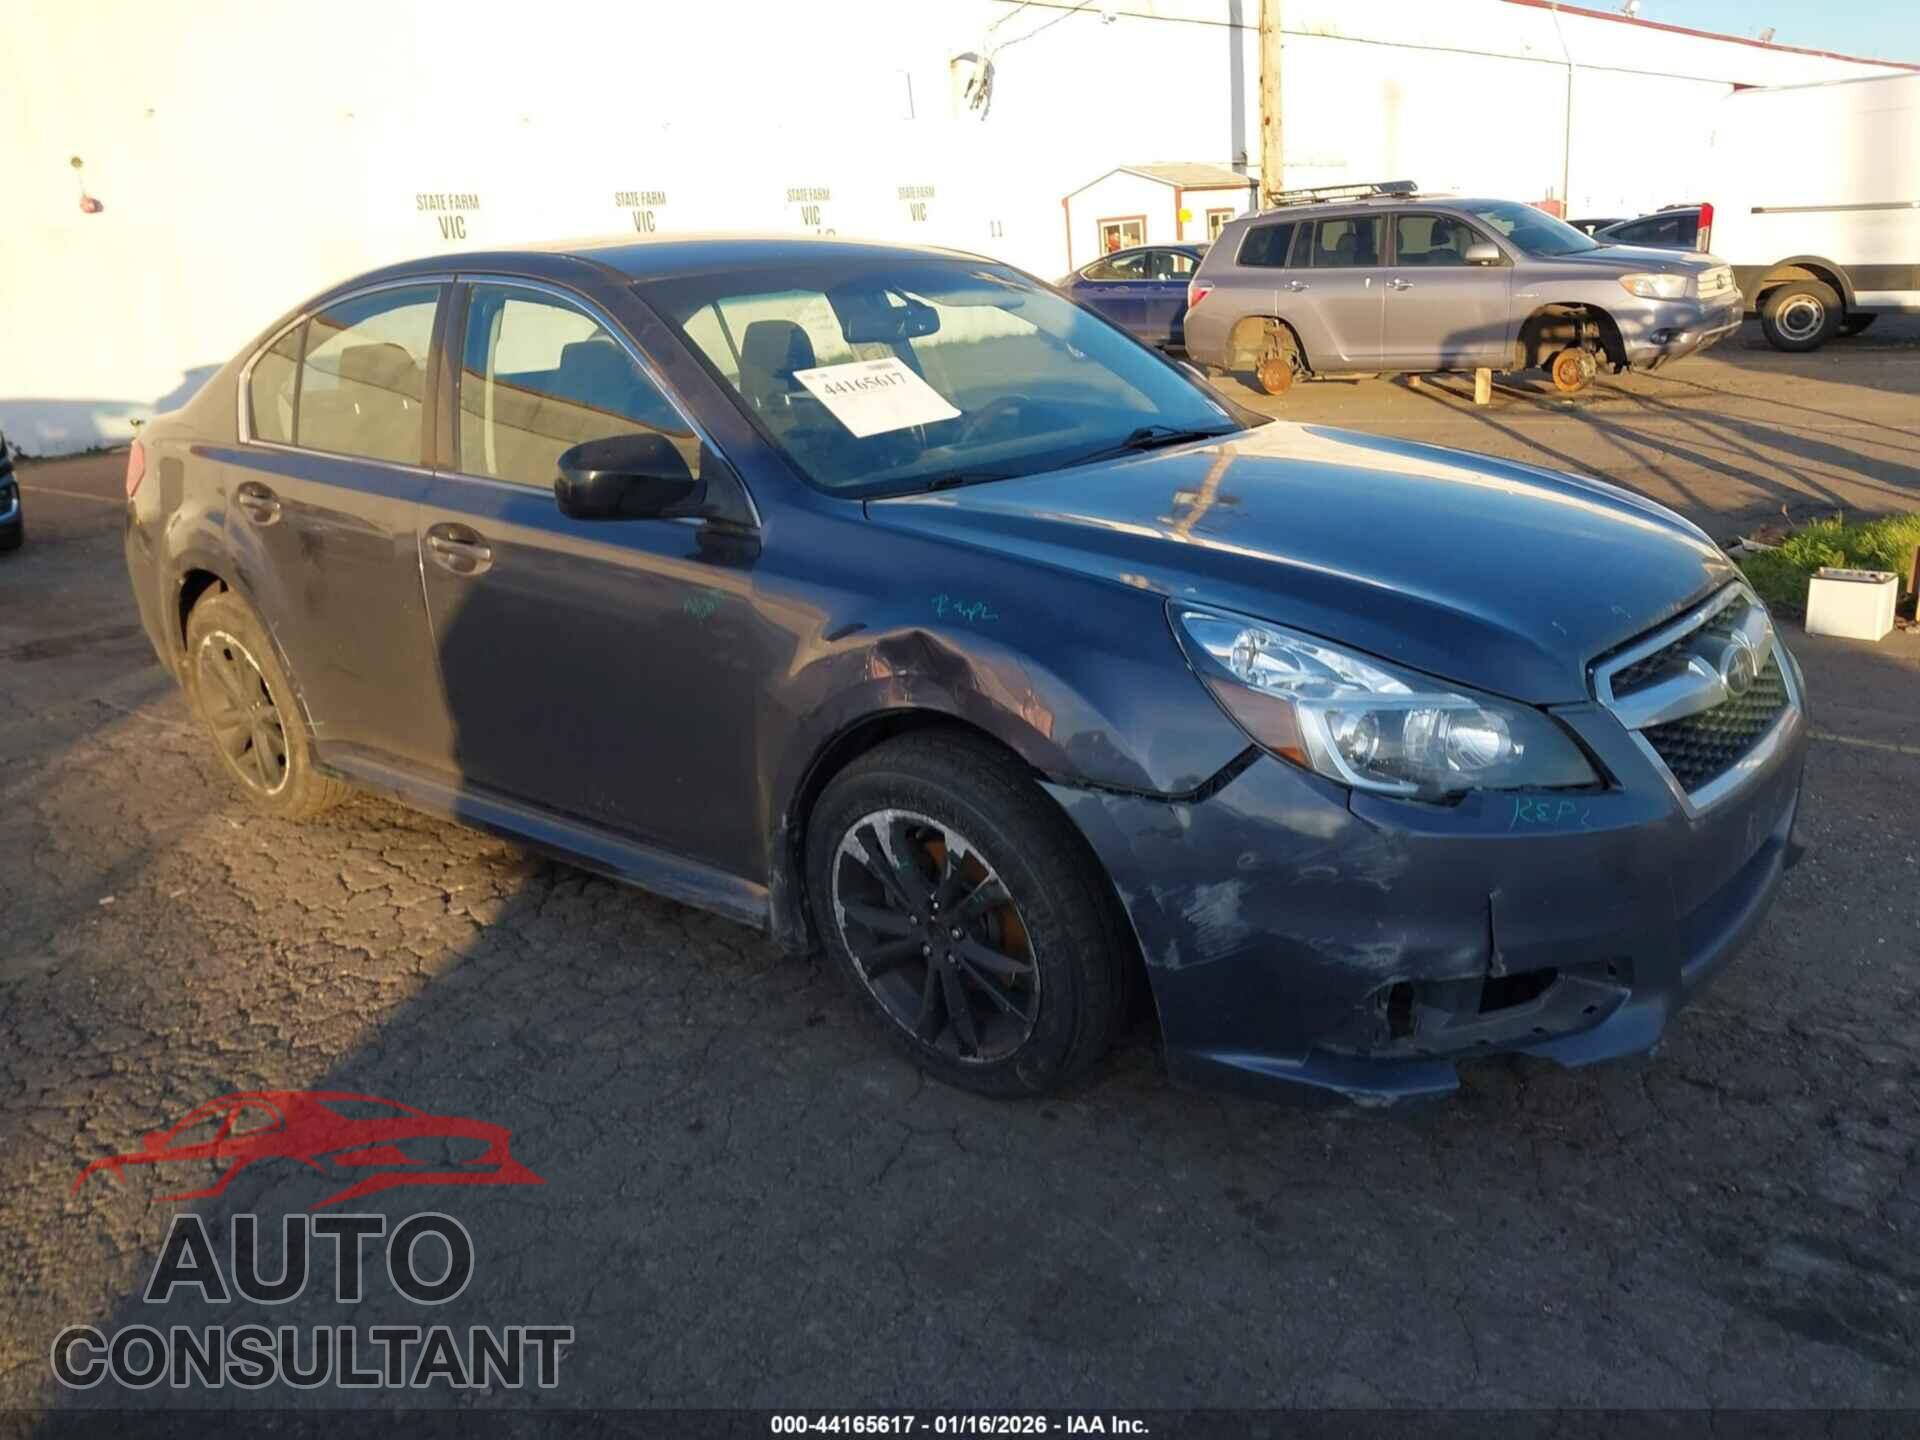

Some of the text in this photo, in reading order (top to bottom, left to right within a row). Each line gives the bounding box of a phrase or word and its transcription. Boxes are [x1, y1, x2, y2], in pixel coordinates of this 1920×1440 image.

[416, 193, 480, 211] STATE FARM
[615, 191, 667, 208] STATE FARM
[632, 210, 656, 232] VIC
[801, 205, 821, 226] VIC
[910, 202, 927, 222] VIC
[438, 215, 467, 240] VIC
[824, 372, 906, 395] 44165617
